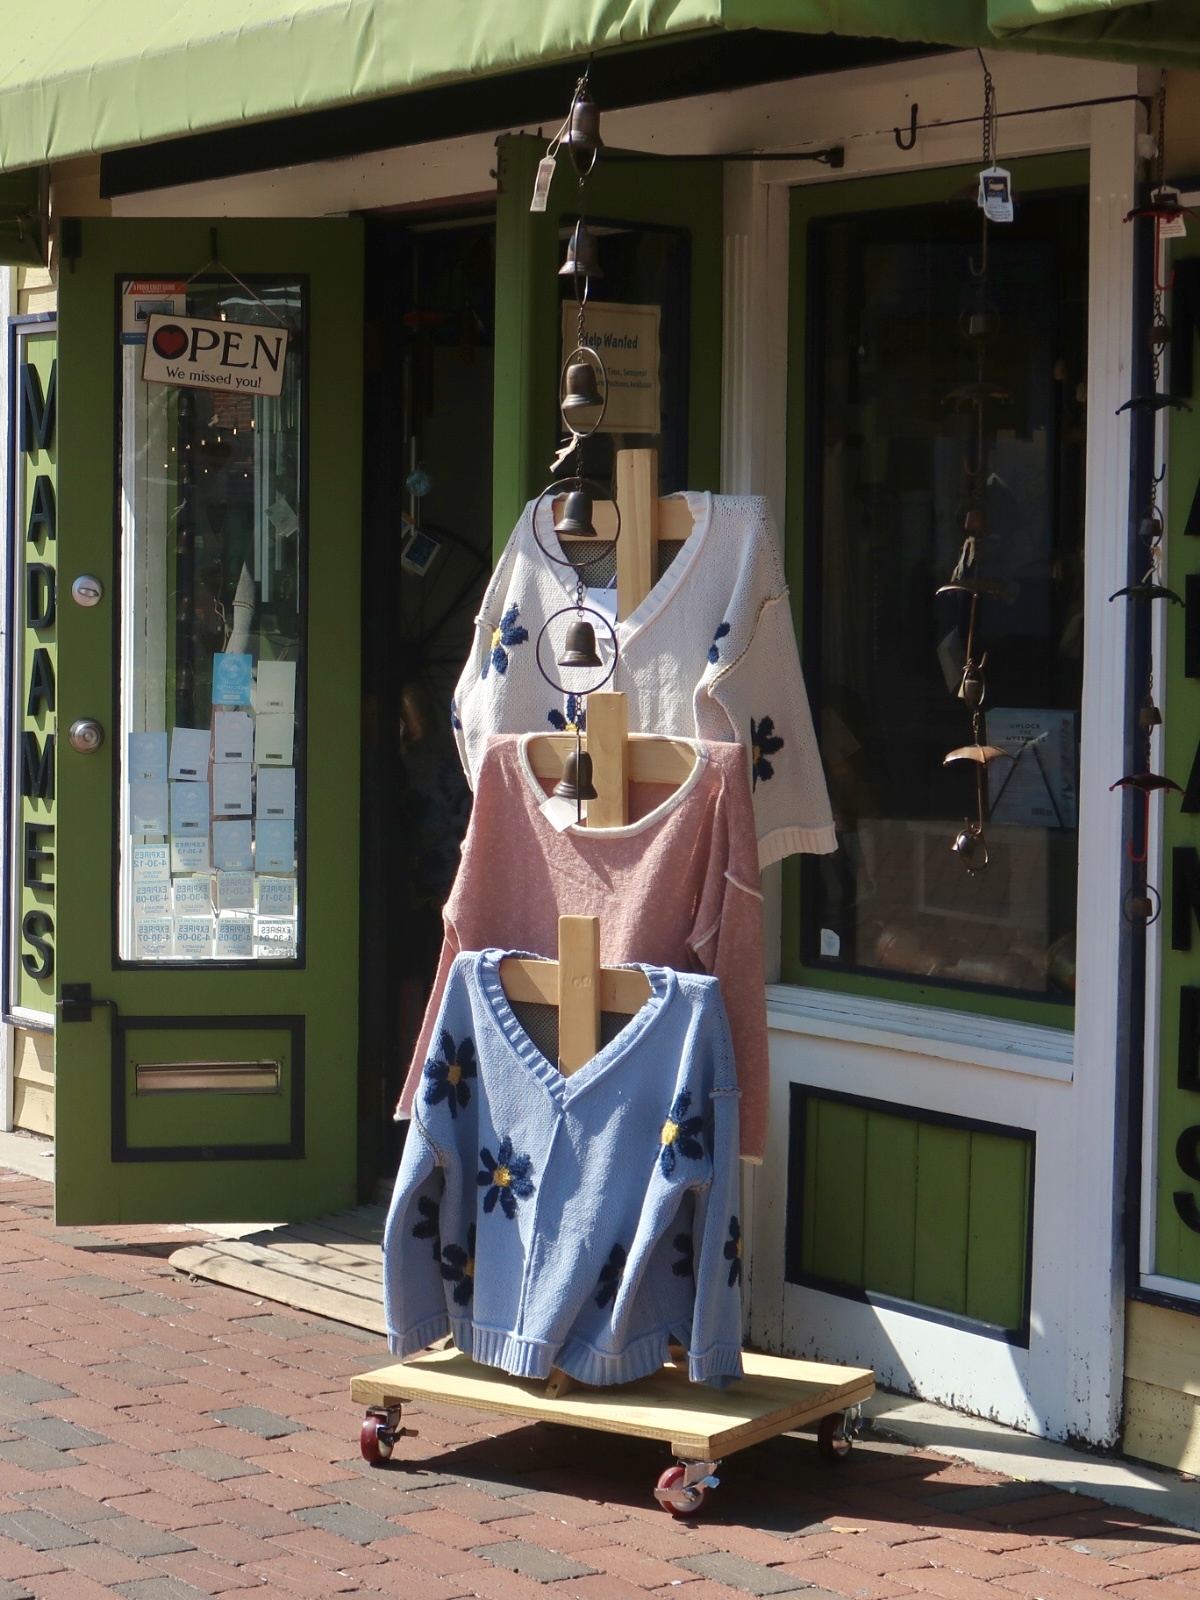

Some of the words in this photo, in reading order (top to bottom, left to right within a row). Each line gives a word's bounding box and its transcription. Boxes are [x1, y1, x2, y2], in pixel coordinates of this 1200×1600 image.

[153, 324, 283, 372] OPEN
[604, 333, 638, 349] Wanted
[166, 366, 186, 379] We
[189, 370, 232, 386] missed
[235, 376, 262, 388] you!
